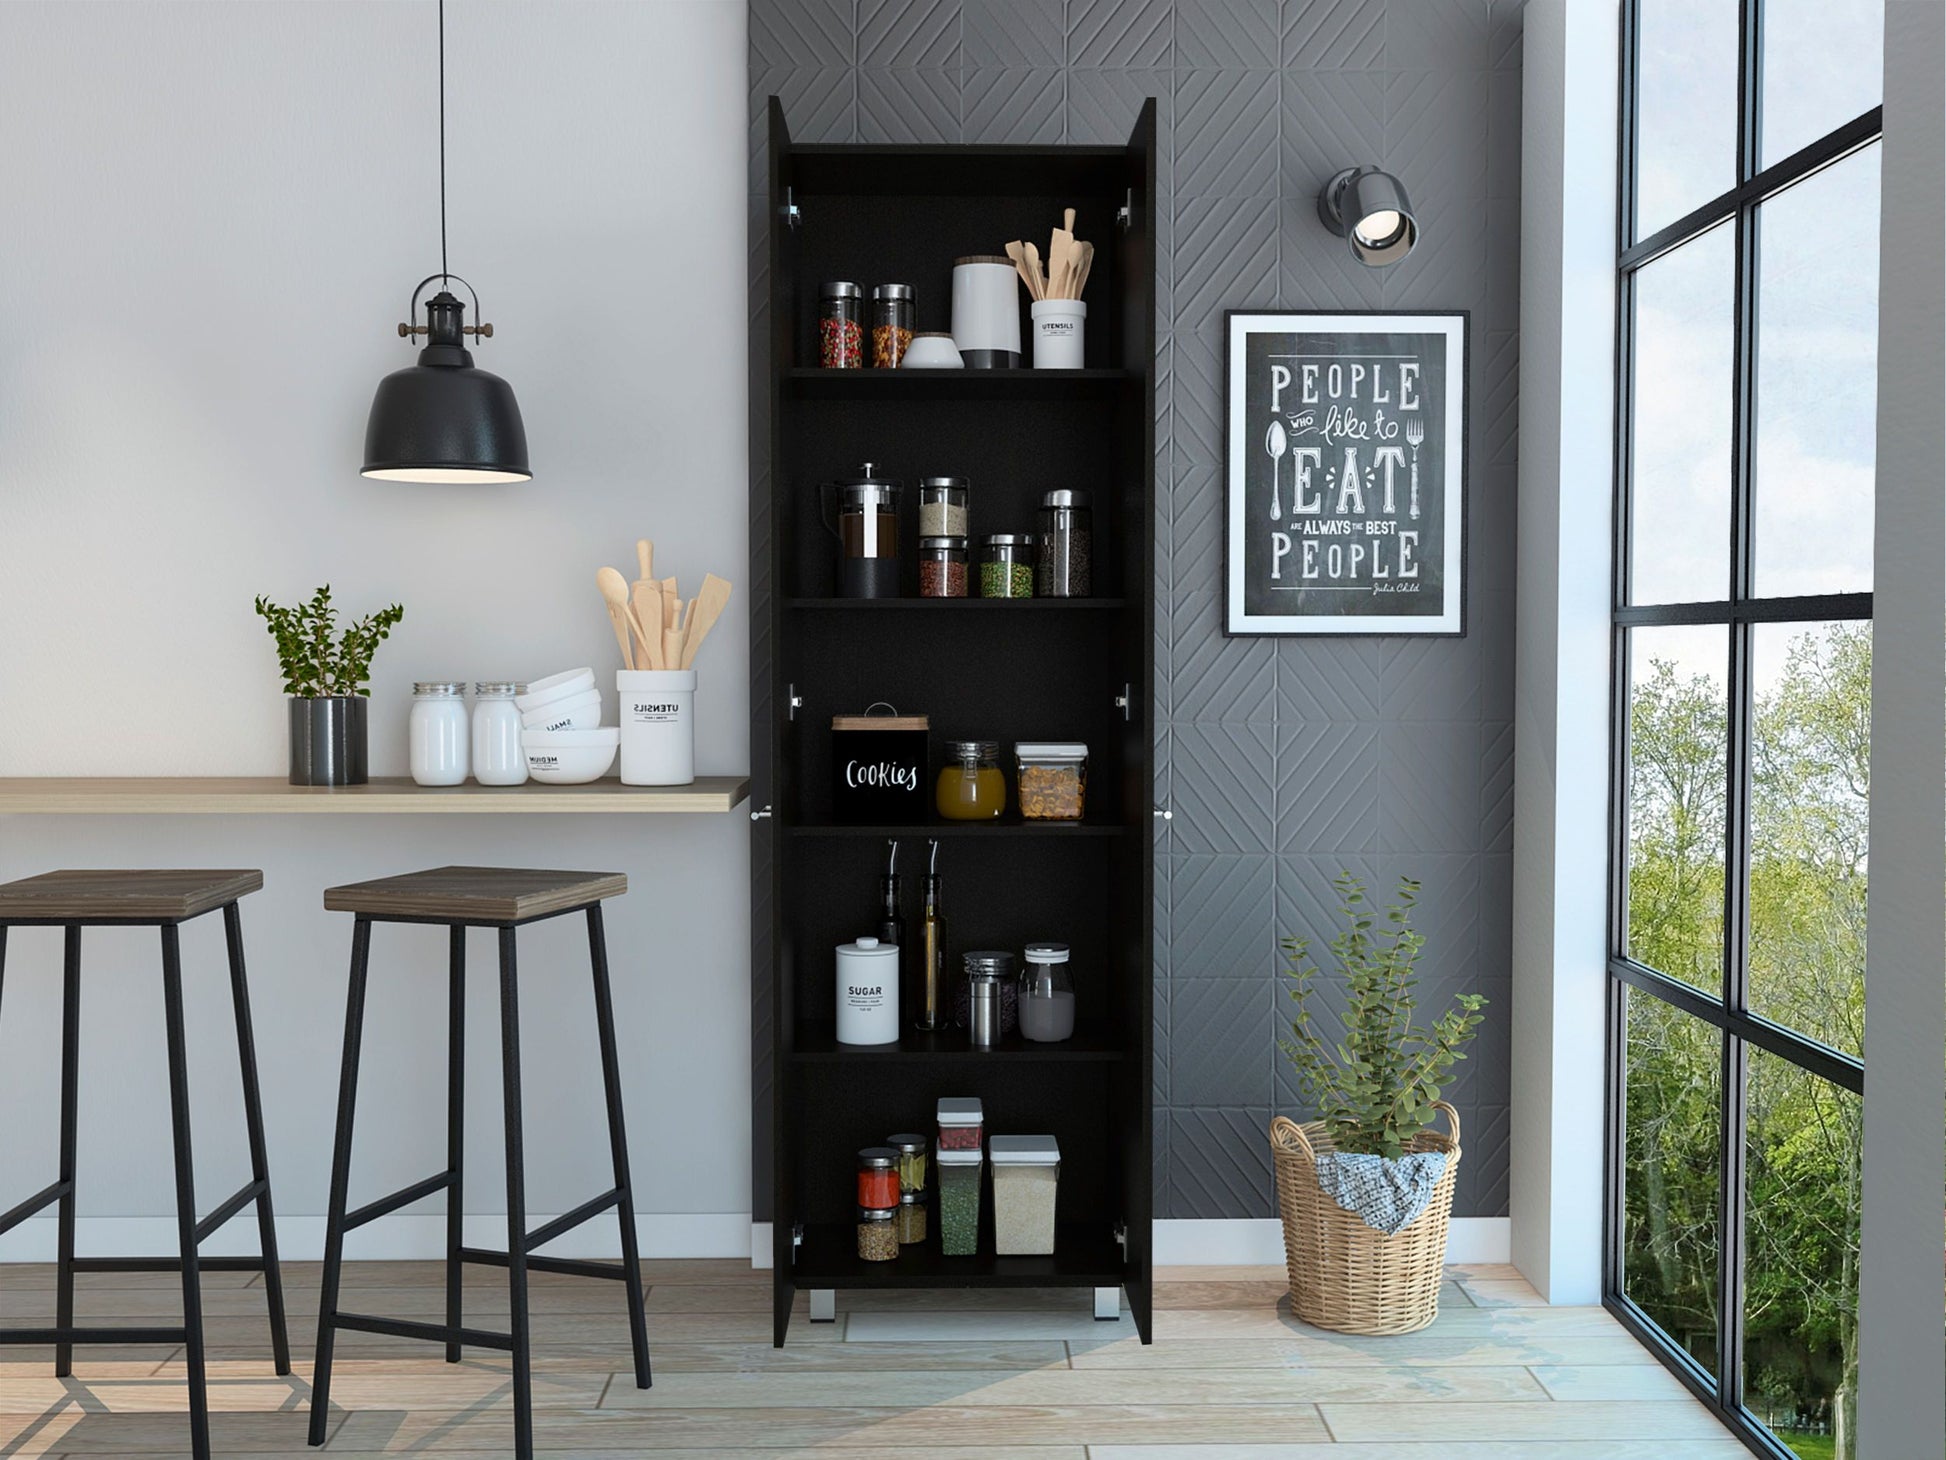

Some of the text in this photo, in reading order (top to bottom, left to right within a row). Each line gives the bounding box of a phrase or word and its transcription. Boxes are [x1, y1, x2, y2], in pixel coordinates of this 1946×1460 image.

[1271, 363, 1419, 412] PEOPLE
[1290, 405, 1399, 446] WHO like to
[1293, 447, 1405, 514] EAT
[1290, 519, 1397, 535] ARE ALWAYS THE BEST
[1271, 531, 1419, 579] PEOPLE
[1372, 582, 1420, 596] Julia Child
[848, 986, 882, 996] SUGAR
